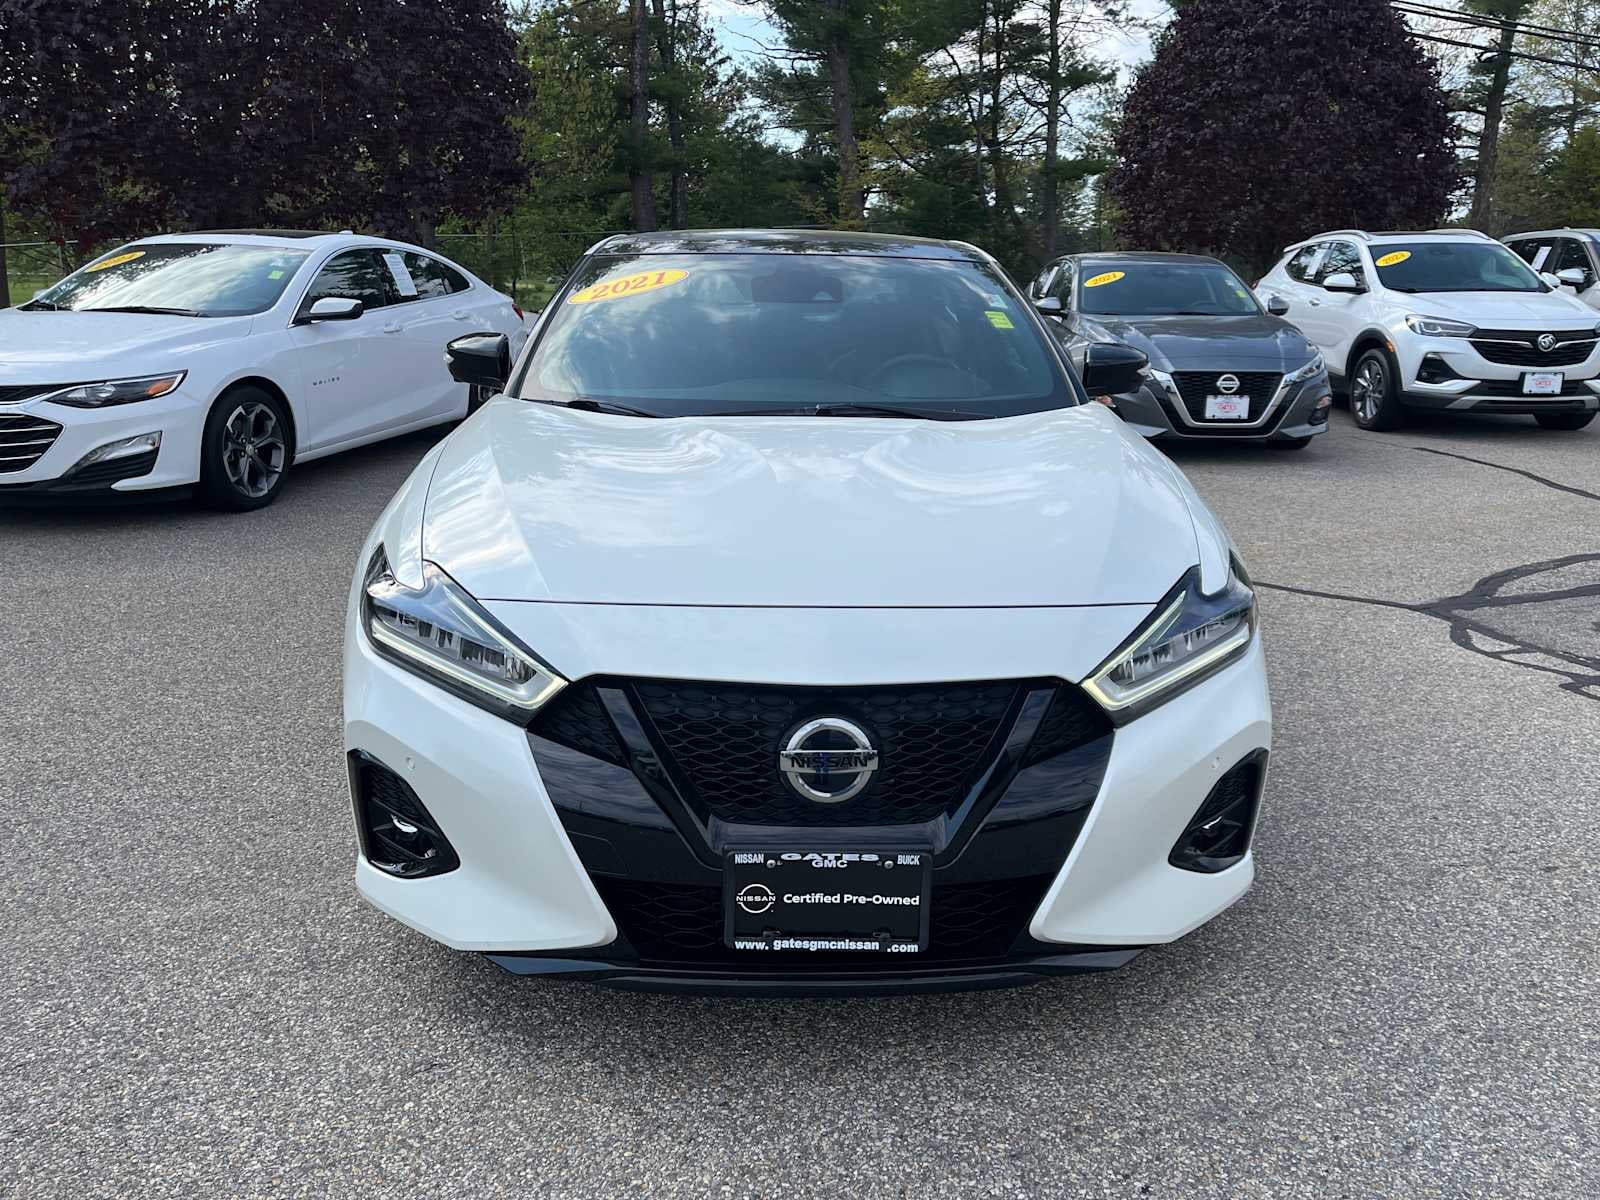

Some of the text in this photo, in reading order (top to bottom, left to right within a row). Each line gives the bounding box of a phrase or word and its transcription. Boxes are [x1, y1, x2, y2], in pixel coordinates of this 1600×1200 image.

[590, 271, 666, 300] 2021
[791, 755, 868, 769] NISSAN
[734, 853, 764, 864] NISSAN
[780, 853, 880, 861] GATES
[897, 854, 920, 866] BUICK
[811, 859, 848, 868] GMC
[736, 894, 776, 902] NISSAN
[783, 893, 920, 906] Certified Pre-Owned
[735, 938, 919, 952] www. gatesgmcnissan .com
